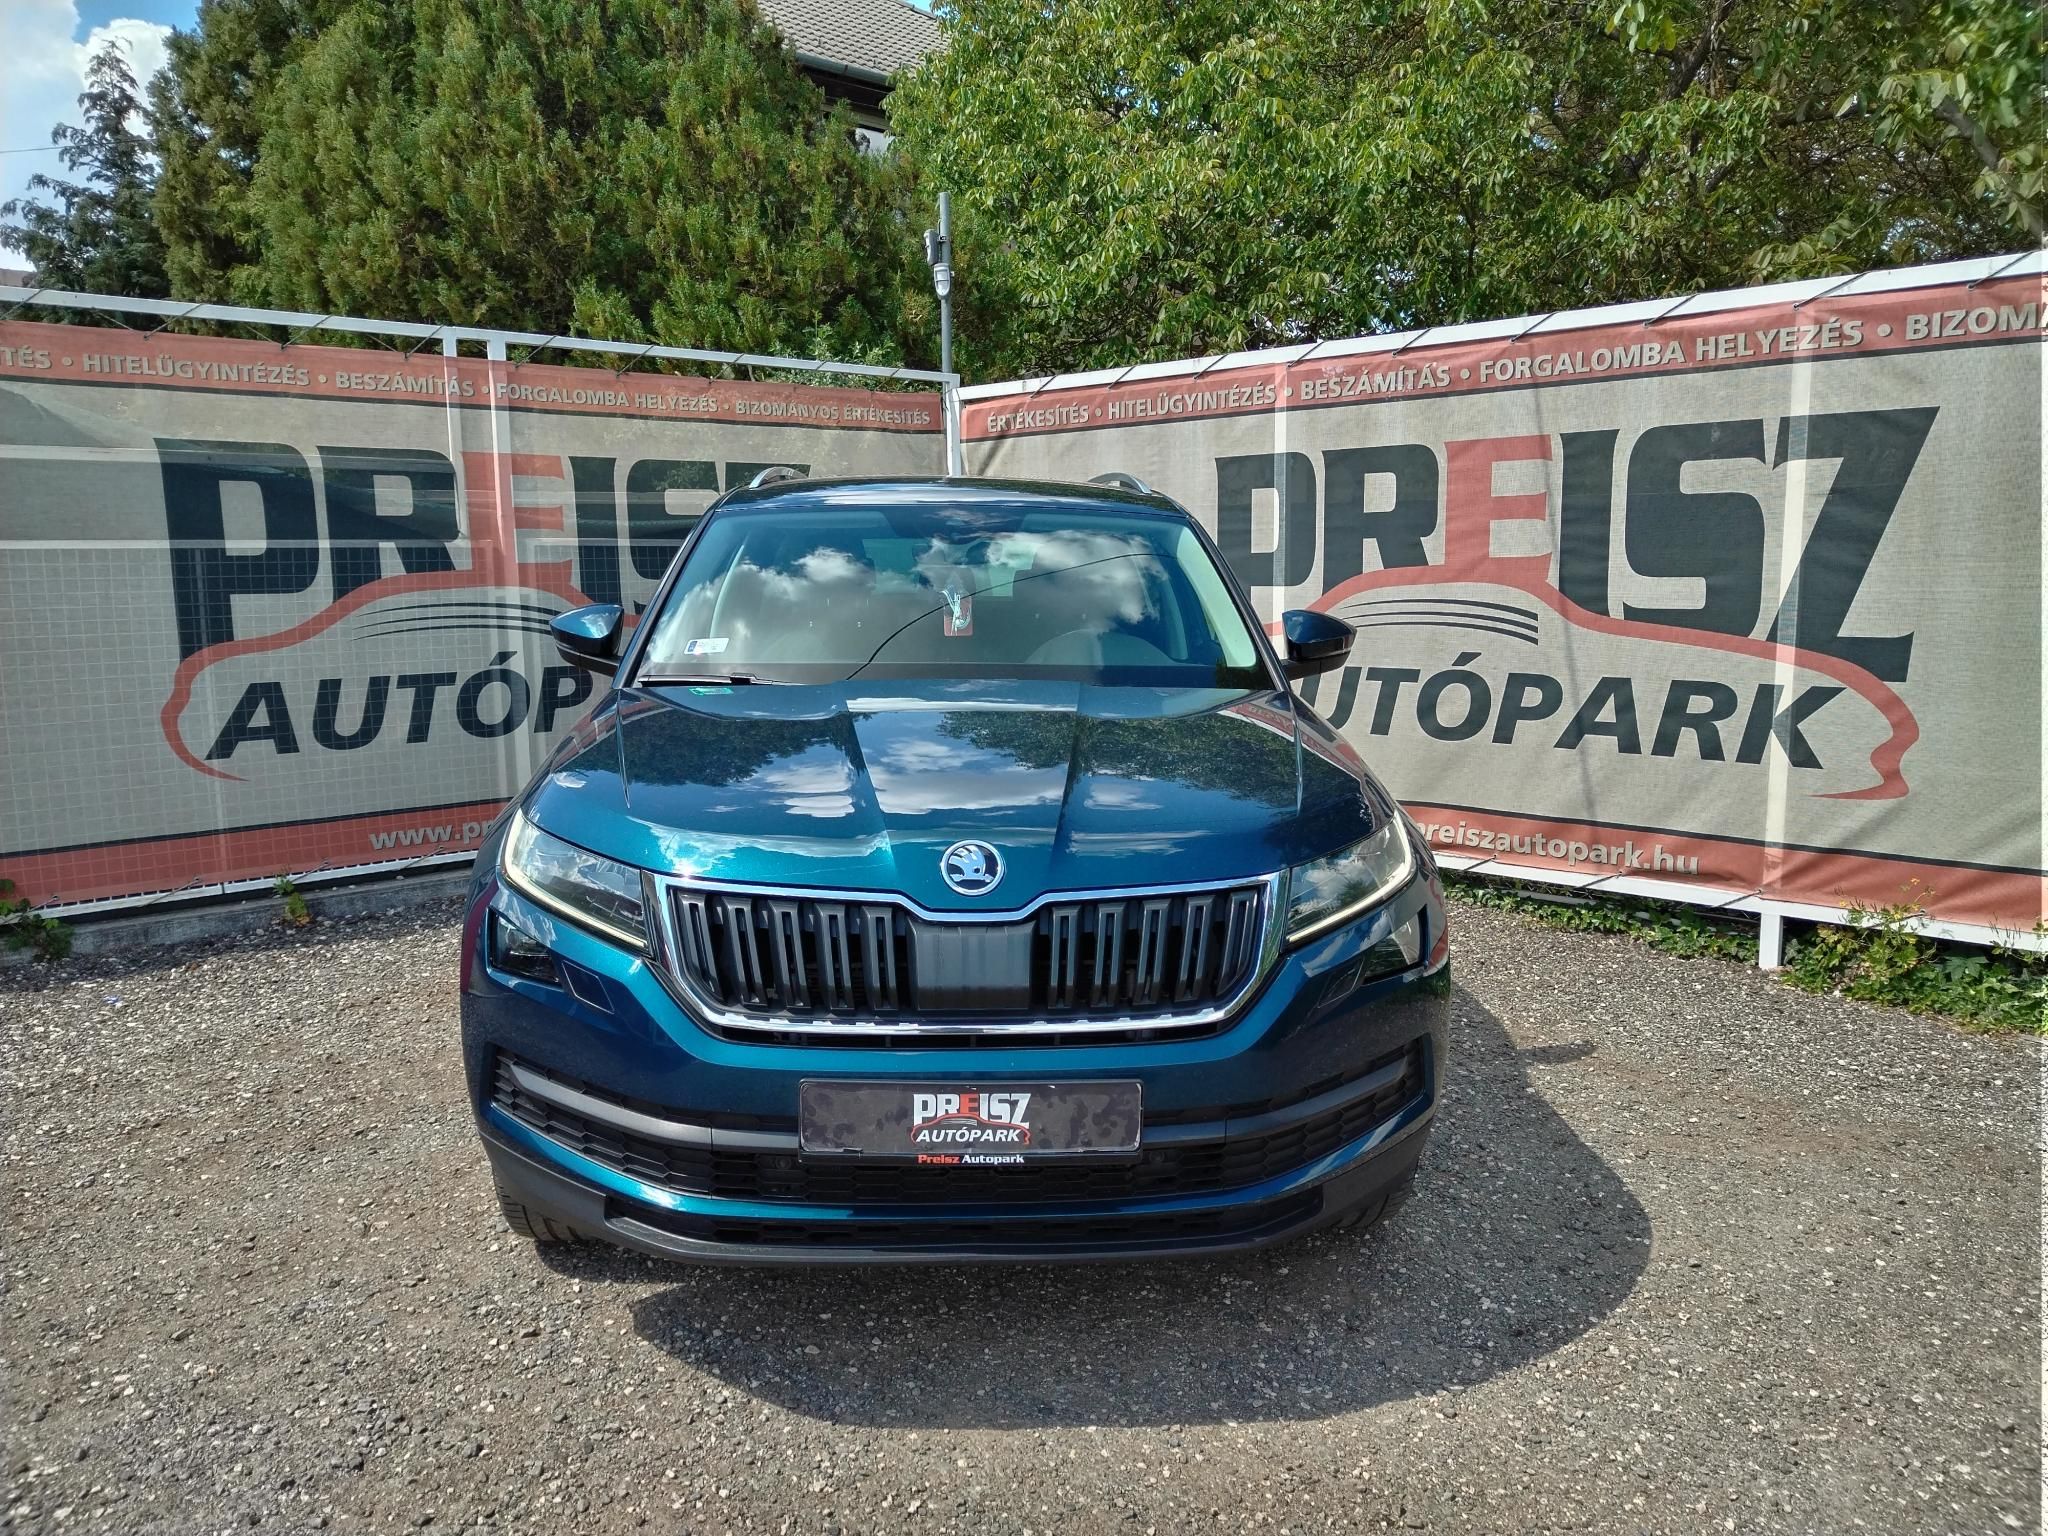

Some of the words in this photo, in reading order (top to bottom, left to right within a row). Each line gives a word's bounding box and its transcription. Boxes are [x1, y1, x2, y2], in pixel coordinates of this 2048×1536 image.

[82, 352, 310, 387] HITELÜGYINTÉZÉS
[336, 370, 476, 398] BESZÁMÍTÁS
[495, 383, 630, 408] FORGALOMBA
[635, 392, 718, 413] HELYEZÉS
[735, 399, 841, 421] BIZOMÁNYOS
[843, 402, 931, 425] ÉRTÉKESÍTÉS
[987, 402, 1090, 433] ÉRTÉKESÍTÉS
[1108, 380, 1276, 420] HITELÜGYINTÉZÉS
[1301, 363, 1451, 400] BESZÁMÍTÁS
[1480, 340, 1685, 384] FORGALOMBA
[1696, 316, 1863, 360] HELYEZÉS
[153, 437, 811, 664] PREIS
[1215, 406, 1940, 682] PREISZ
[913, 1093, 1031, 1129] PREISZ
[916, 1126, 1021, 1143] AUTÓPARK
[918, 1154, 960, 1164] Preisz
[962, 1154, 1024, 1165] Autopark
